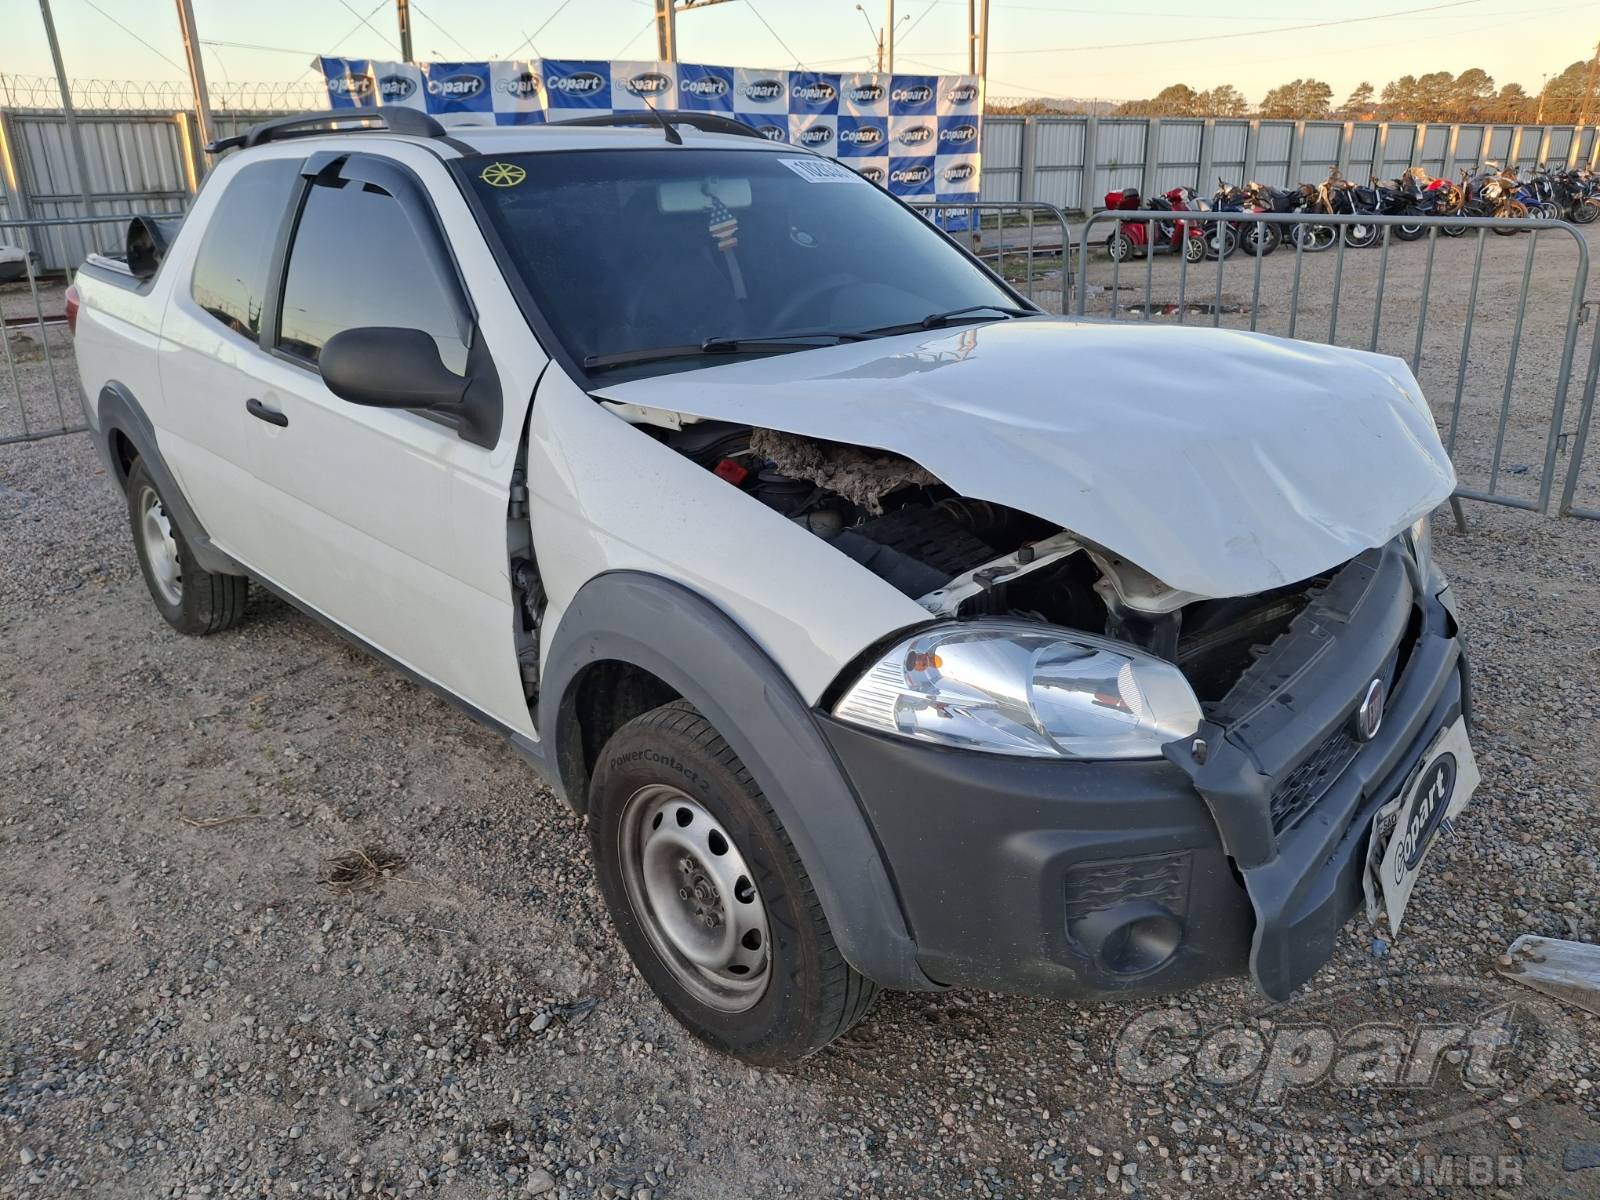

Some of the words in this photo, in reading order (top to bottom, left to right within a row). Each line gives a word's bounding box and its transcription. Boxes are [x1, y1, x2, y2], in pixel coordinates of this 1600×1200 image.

[547, 76, 599, 92] Copart
[680, 79, 724, 95] Copart
[792, 86, 833, 101] Copart
[892, 89, 928, 101] Copart
[841, 130, 880, 143] Copart
[940, 129, 974, 142] Copart
[890, 169, 928, 181] Copart
[610, 748, 700, 783] PowerContact
[699, 779, 711, 793] 2
[1394, 767, 1445, 886] Copart
